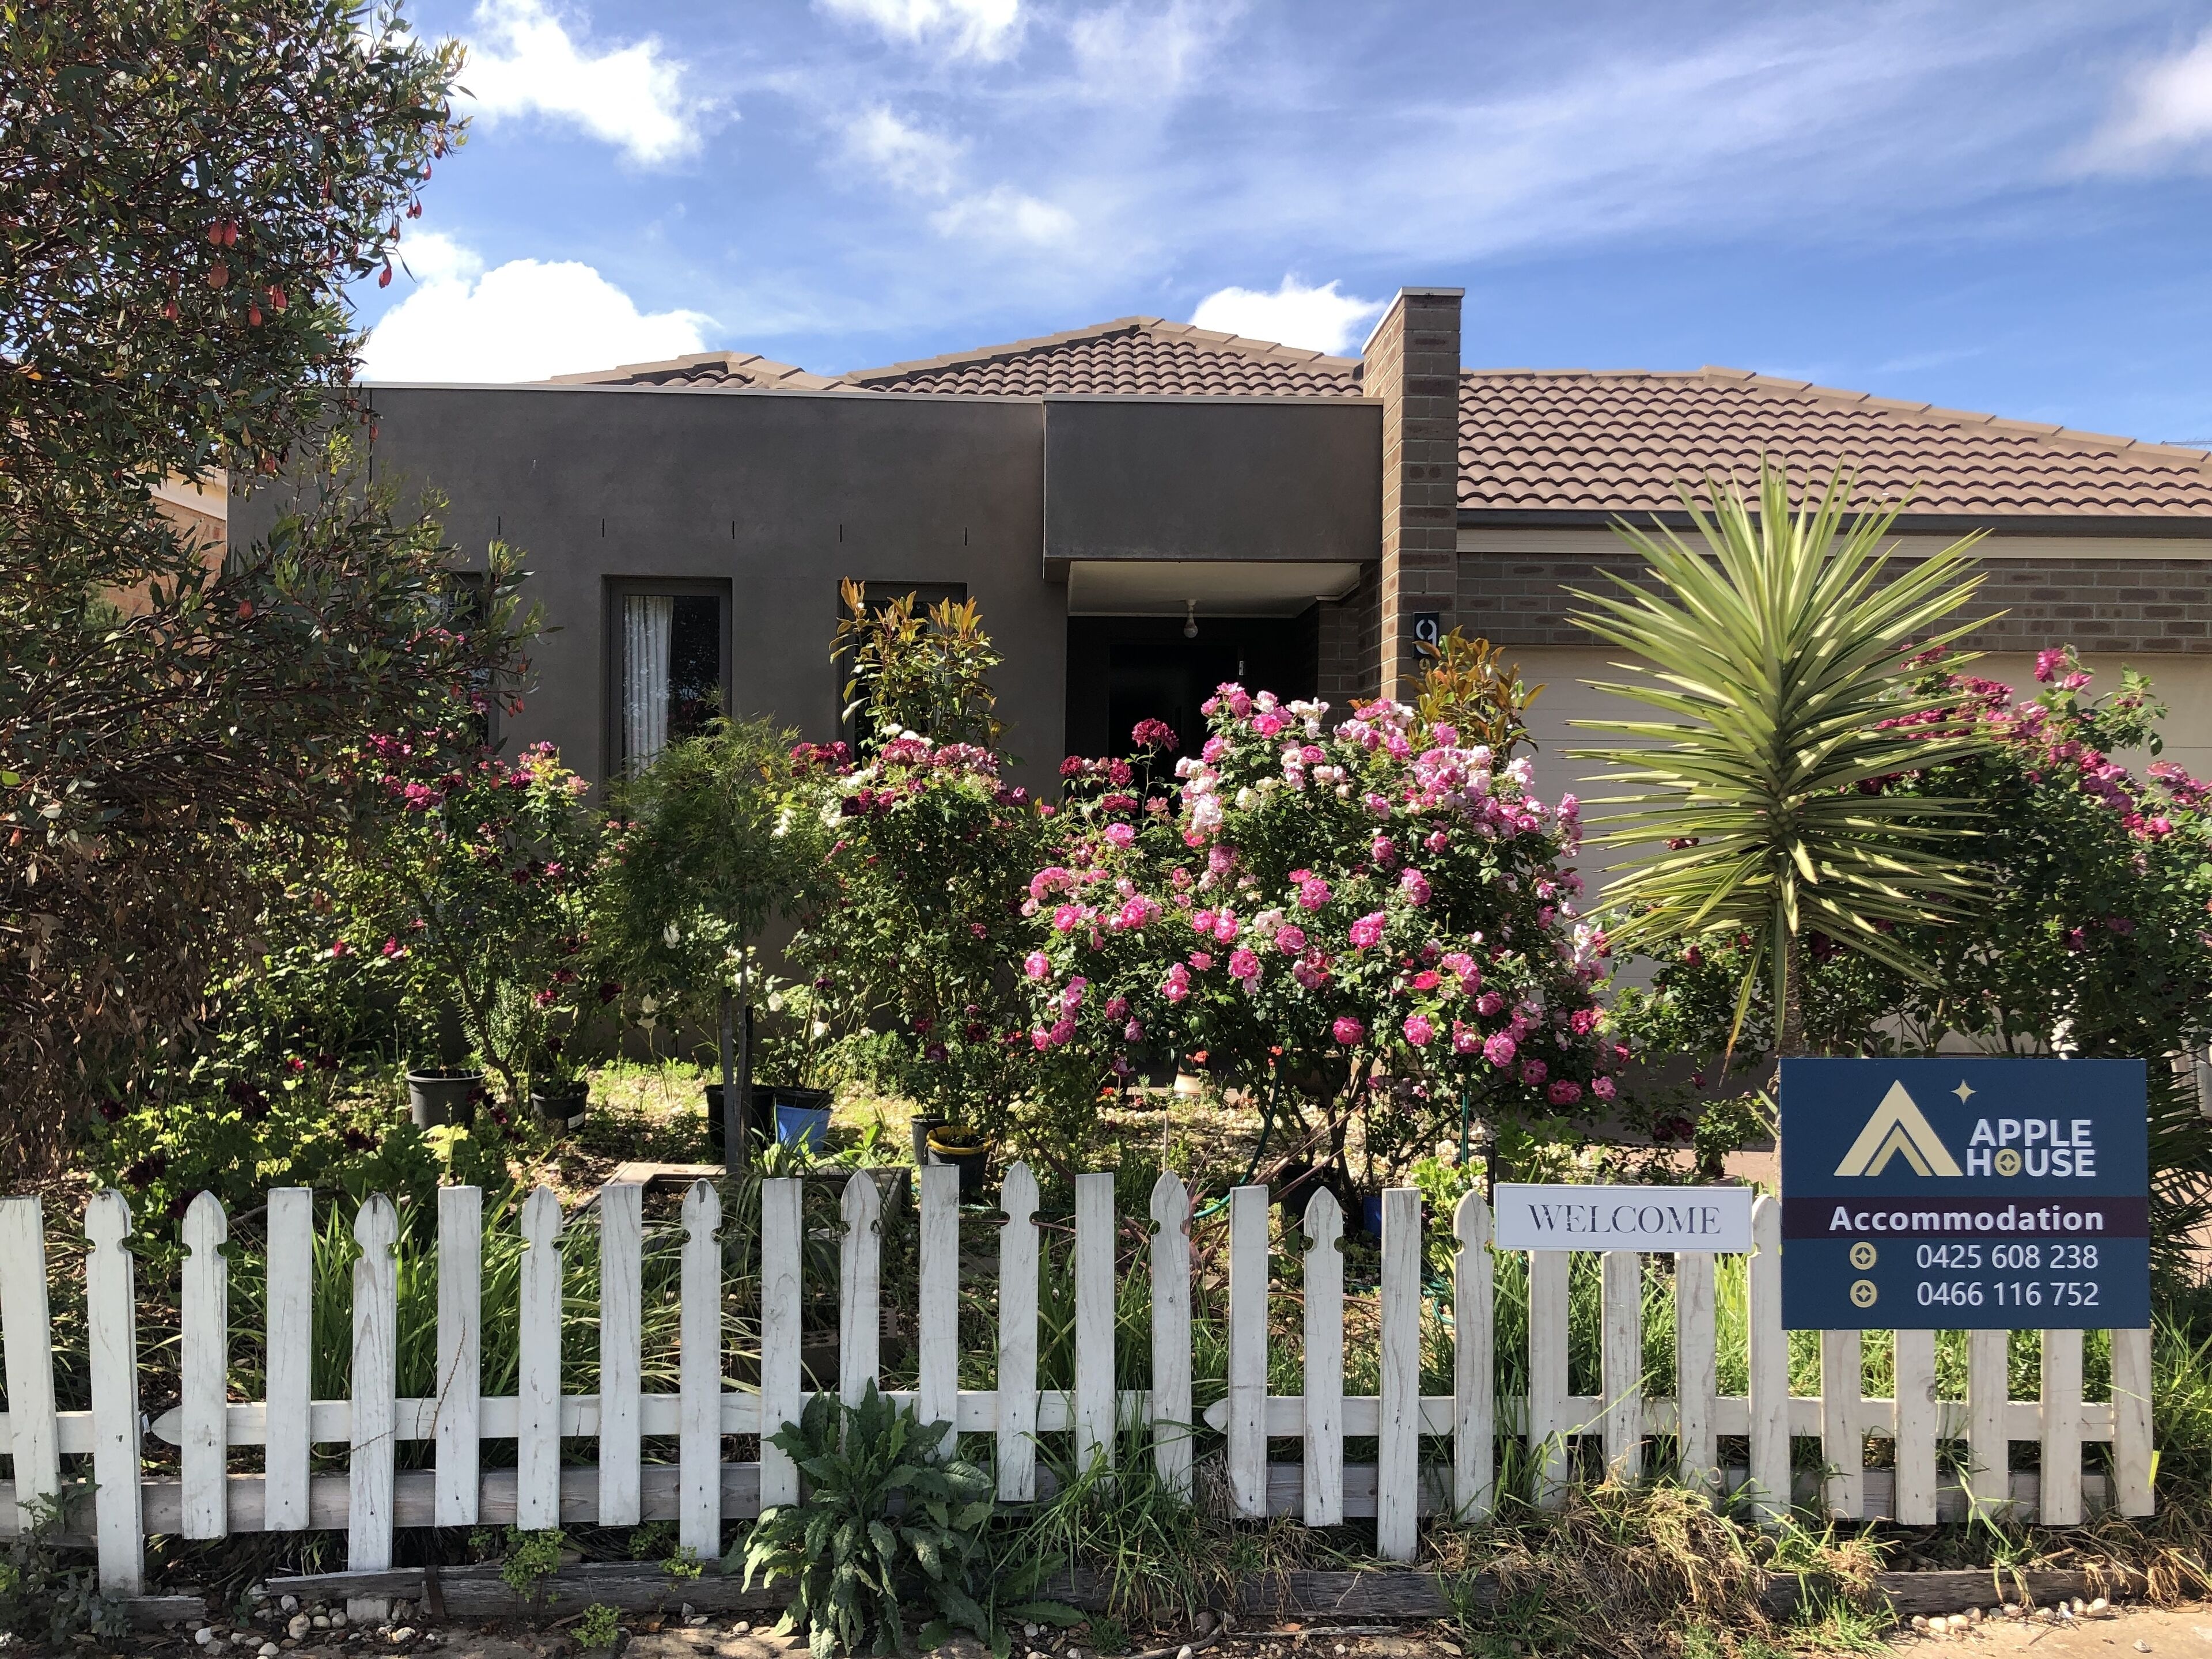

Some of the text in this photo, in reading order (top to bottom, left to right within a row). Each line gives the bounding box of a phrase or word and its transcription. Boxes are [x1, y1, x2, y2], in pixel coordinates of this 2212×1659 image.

[1416, 619, 1437, 654] 9
[1969, 1119, 2092, 1147] APPLE
[1967, 1148, 2096, 1177] HOUSE
[1527, 1204, 1721, 1234] WELCOME
[1829, 1205, 2103, 1231] Accommodation
[1916, 1244, 2099, 1269] 0425 608 238
[1917, 1282, 2099, 1306] 0466 116 752
